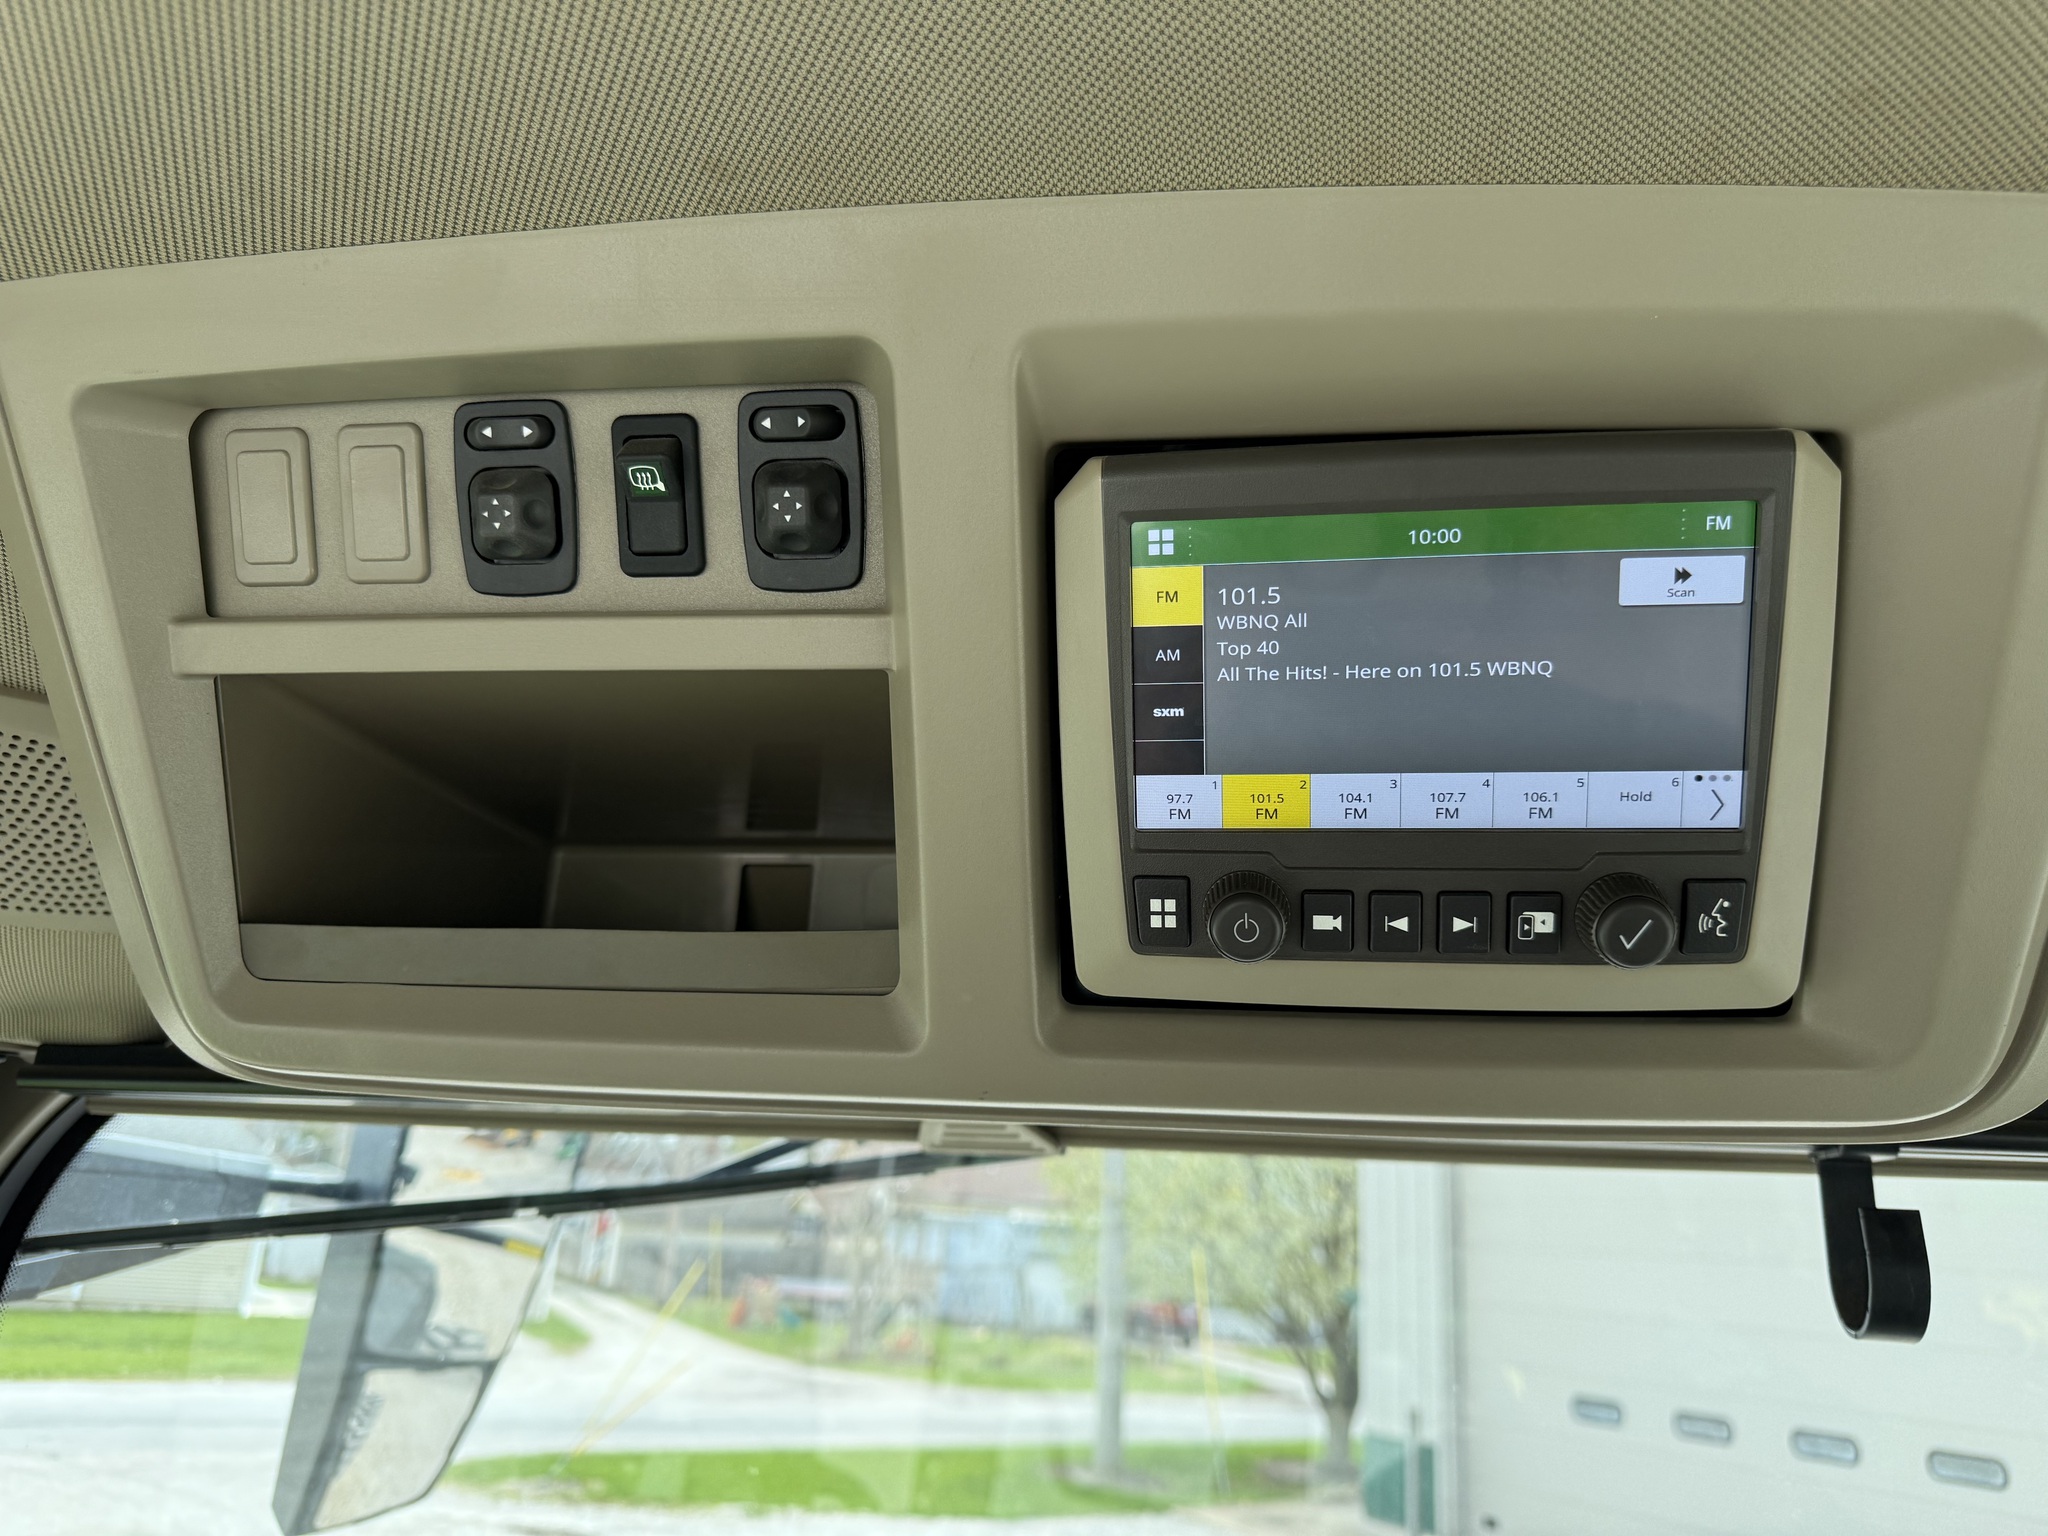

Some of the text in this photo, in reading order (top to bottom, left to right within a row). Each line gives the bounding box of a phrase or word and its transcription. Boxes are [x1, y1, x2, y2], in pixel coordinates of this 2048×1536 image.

[1706, 515, 1731, 531] FM
[1408, 528, 1462, 545] 10:00
[1156, 590, 1179, 604] FM
[1218, 586, 1281, 606] 101.5
[1666, 588, 1695, 598] Scan
[1216, 612, 1307, 632] WBNQ All
[1155, 648, 1180, 662] AM
[1216, 640, 1280, 660] Top 40
[1216, 666, 1240, 682] All
[1244, 666, 1280, 681] The
[1286, 665, 1327, 681] Hits!
[1345, 664, 1391, 679] Here
[1397, 666, 1422, 678] on
[1429, 662, 1481, 678] 101.5
[1486, 660, 1553, 678] WBNQ
[1152, 707, 1185, 718] sxm
[1211, 780, 1217, 790] 1
[1299, 780, 1307, 790] 2
[1389, 779, 1398, 789] 3
[1482, 778, 1491, 789] 4
[1576, 777, 1585, 788] 5
[1671, 777, 1680, 788] 6
[1166, 793, 1193, 804] 97.7
[1250, 793, 1285, 804] 101.5
[1338, 792, 1372, 804] 104.1
[1430, 792, 1466, 803] 107.7
[1523, 791, 1558, 803] 106.1
[1620, 791, 1652, 802] Hold
[1169, 808, 1191, 820] FM
[1256, 808, 1278, 820] FM
[1344, 807, 1367, 820] FM
[1435, 807, 1459, 819] FM
[1528, 807, 1553, 819] FM
